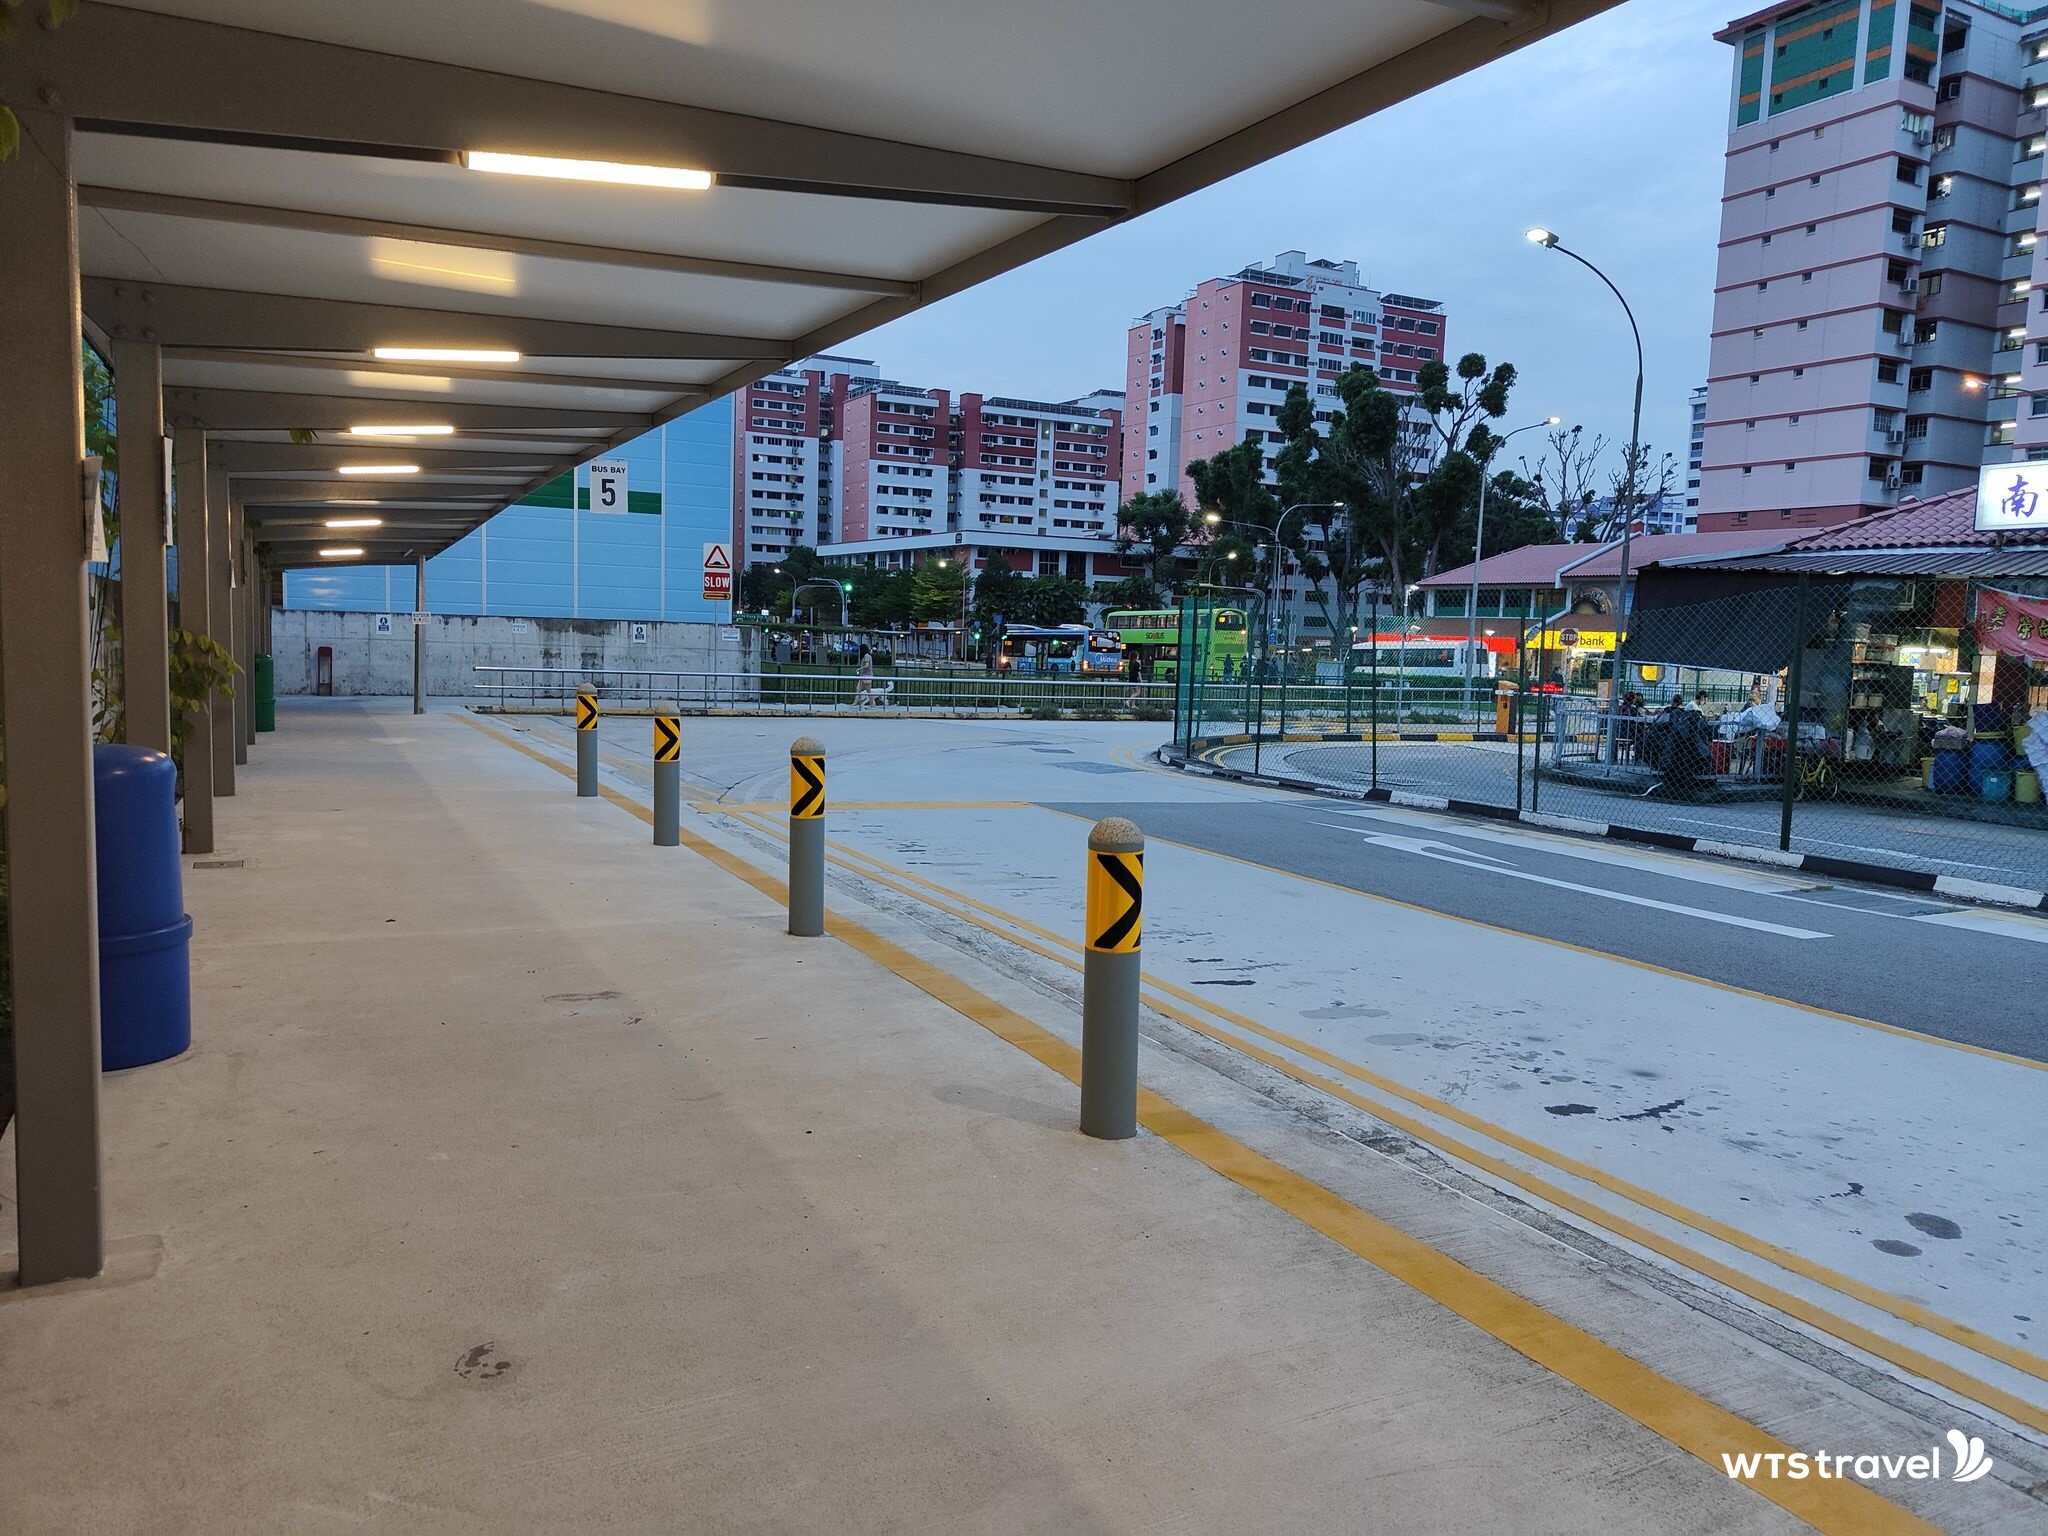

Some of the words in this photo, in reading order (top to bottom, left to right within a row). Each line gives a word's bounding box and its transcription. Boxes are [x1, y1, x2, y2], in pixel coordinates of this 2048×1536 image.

[591, 465, 608, 473] BUS
[601, 478, 616, 507] 5
[2002, 473, 2048, 517] 南
[704, 576, 730, 588] SLOW
[1561, 633, 1578, 641] STOP
[1578, 635, 1604, 646] bank
